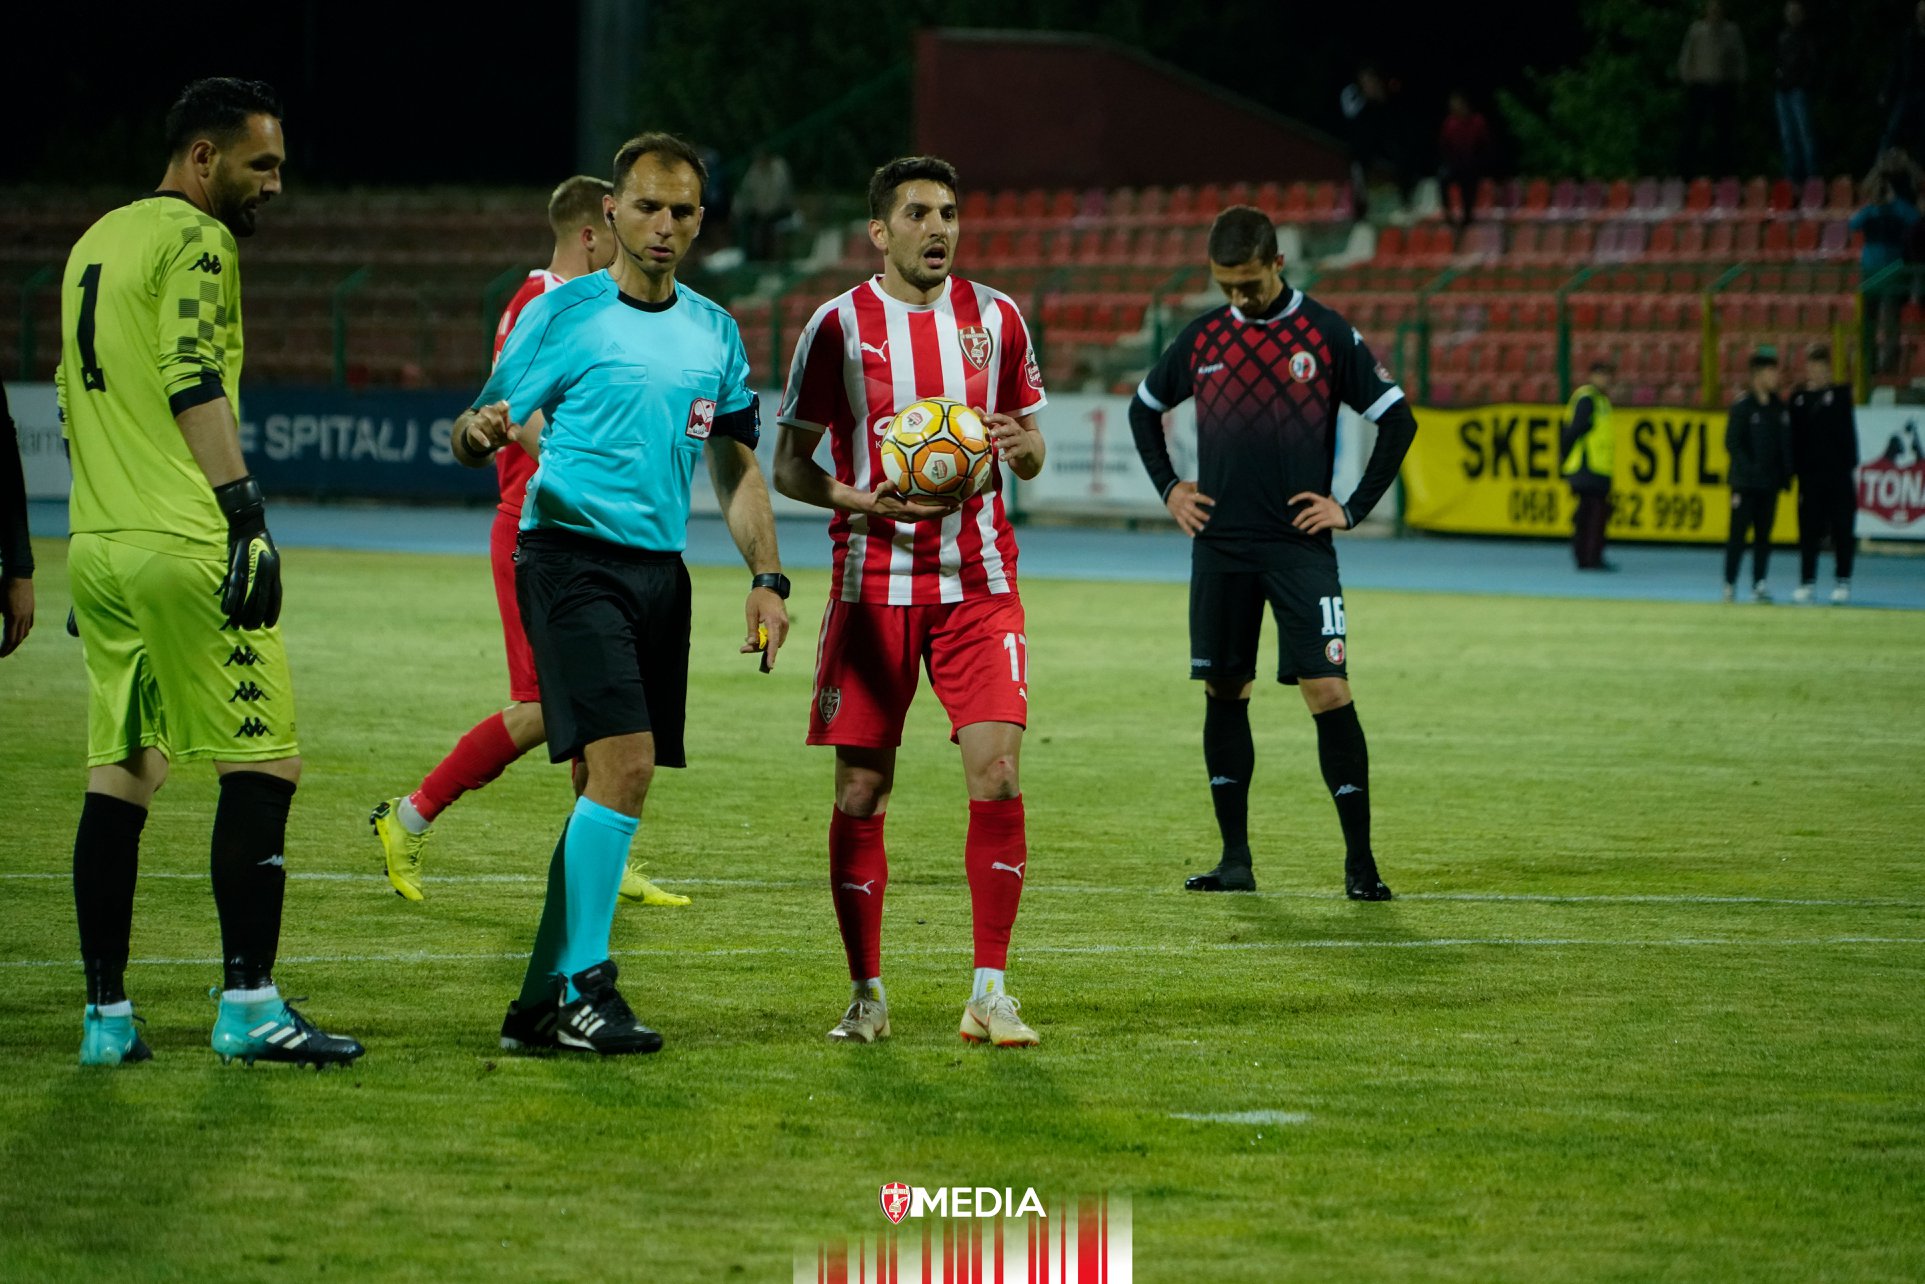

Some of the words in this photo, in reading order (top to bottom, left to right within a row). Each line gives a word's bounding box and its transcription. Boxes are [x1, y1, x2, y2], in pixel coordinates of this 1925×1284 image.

[77, 263, 106, 393] 1
[429, 417, 454, 466] S
[1460, 418, 1564, 479] SKE
[1632, 419, 1721, 484] SYL
[1862, 469, 1925, 509] TON
[1654, 493, 1704, 531] 999
[1319, 596, 1346, 636] 16
